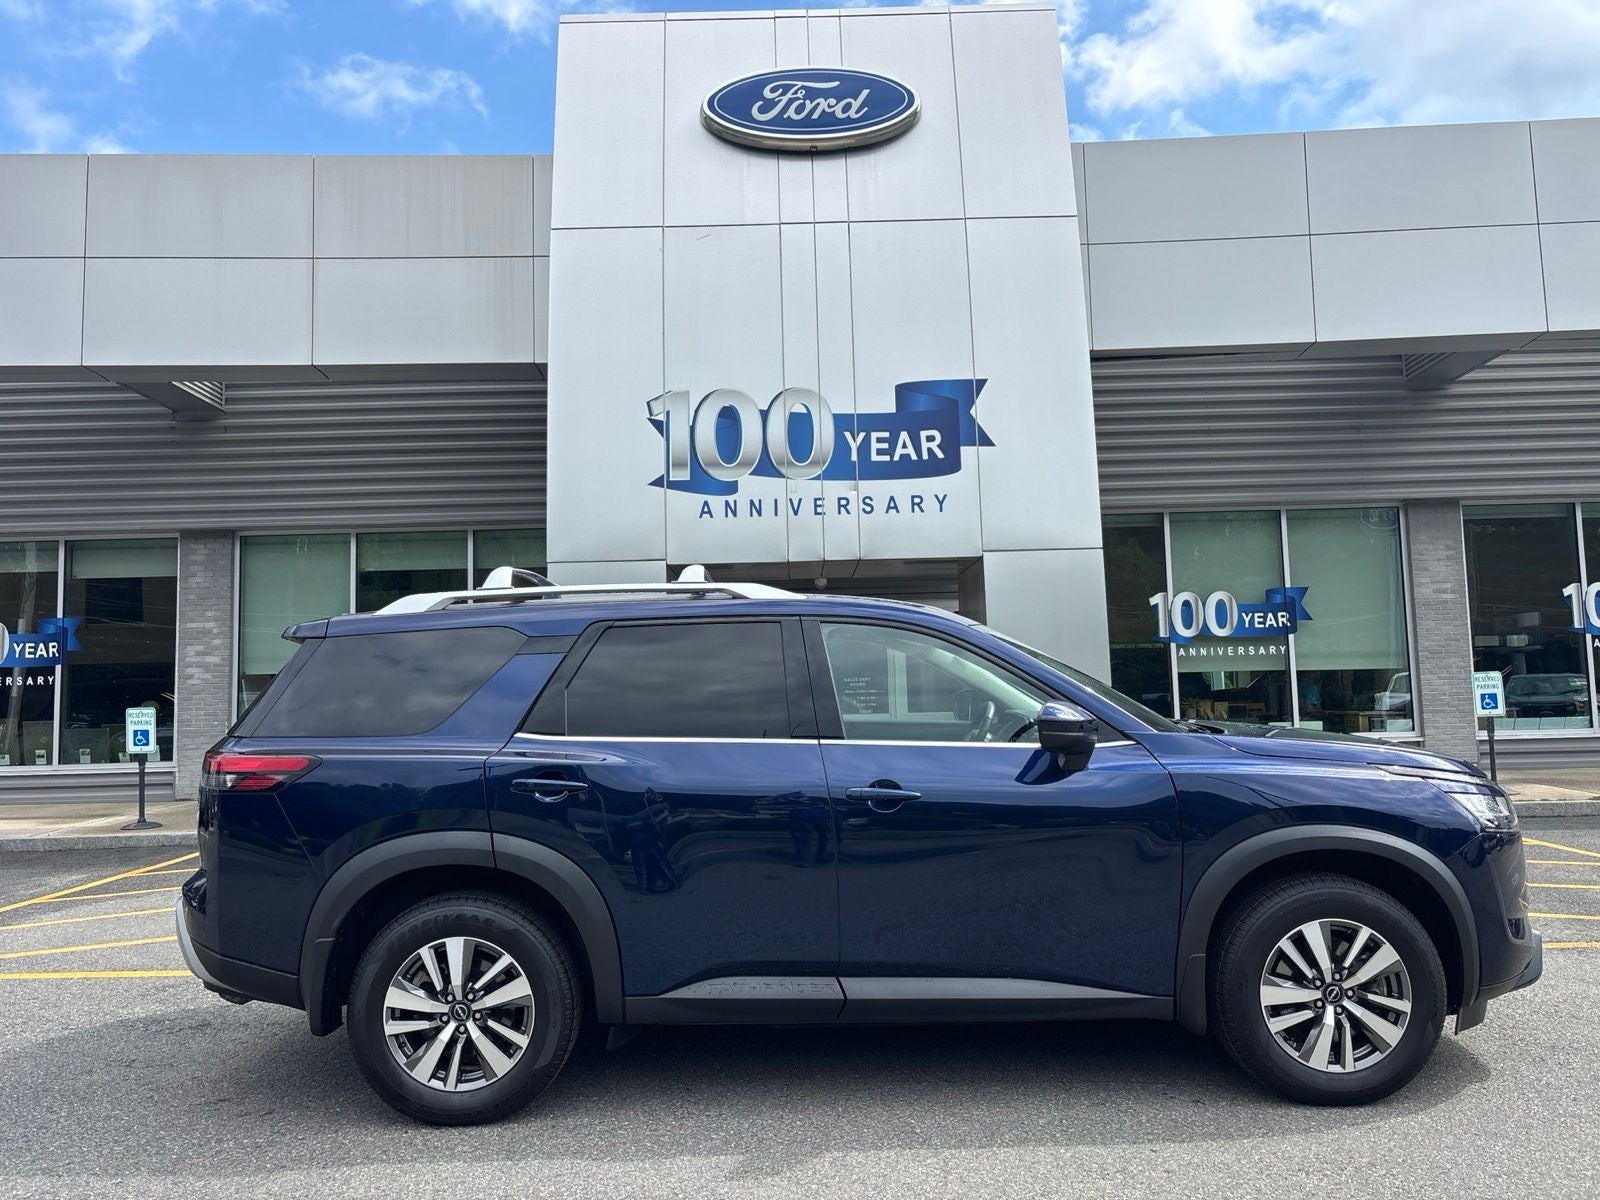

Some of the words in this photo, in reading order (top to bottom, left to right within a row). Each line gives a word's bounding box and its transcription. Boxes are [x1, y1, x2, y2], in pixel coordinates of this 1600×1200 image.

[751, 80, 870, 122] Ford
[646, 386, 835, 481] 100
[843, 428, 946, 462] YEAR
[699, 493, 949, 519] ANNIVERSARY
[1148, 590, 1238, 637] 100
[1241, 611, 1291, 628] YEAR
[13, 642, 59, 658] YEAR
[1178, 645, 1287, 657] ANNIVERSARY
[0, 675, 55, 686] RSARY
[128, 711, 154, 719] RESERVED
[707, 983, 835, 994] PATHFINDER
